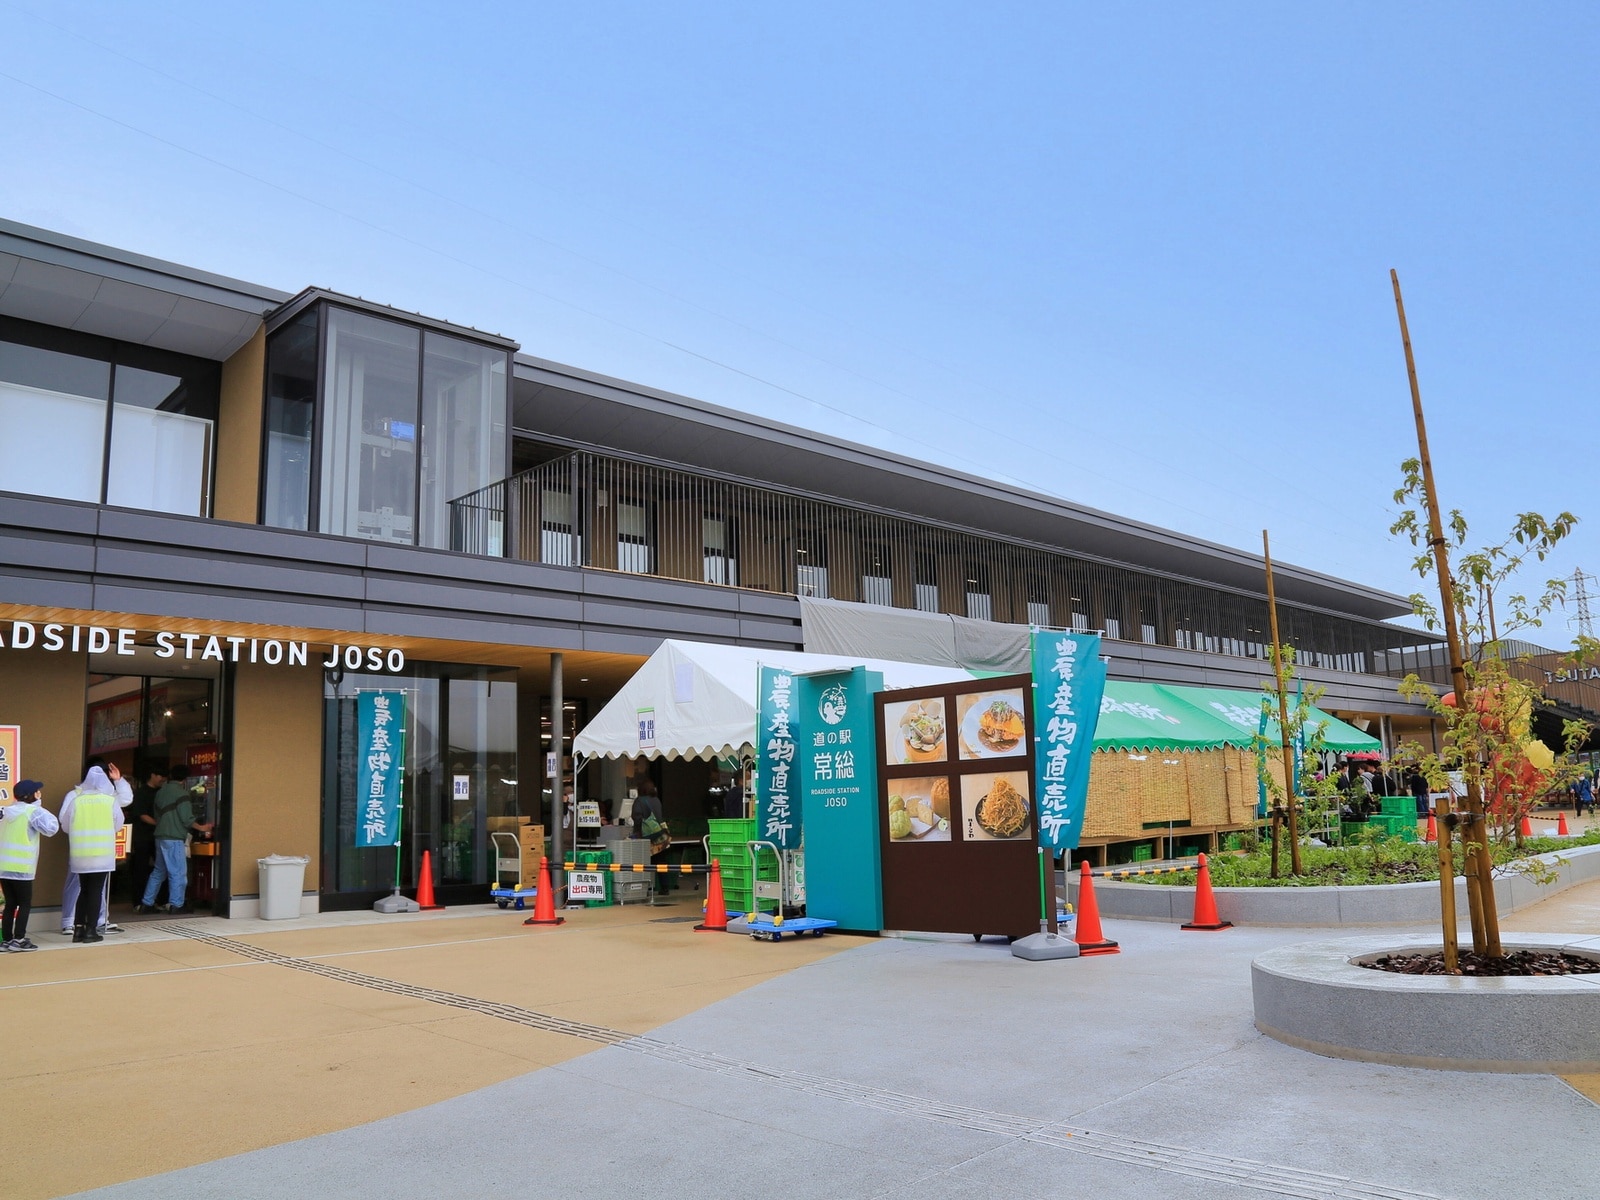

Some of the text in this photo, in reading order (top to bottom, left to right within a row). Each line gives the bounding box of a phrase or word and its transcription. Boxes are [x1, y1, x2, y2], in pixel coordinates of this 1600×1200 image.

[0, 621, 405, 672] DSIDE STATION JOSO
[813, 729, 852, 747] 道の駅
[1041, 638, 1077, 844] 農産物直売所
[765, 674, 795, 846] 農産物直売所
[813, 750, 855, 780] 常総
[811, 787, 836, 795] ROADSIDE
[825, 797, 847, 807] JOSO
[576, 874, 597, 883] 農産物
[572, 885, 603, 895] 出口専用
